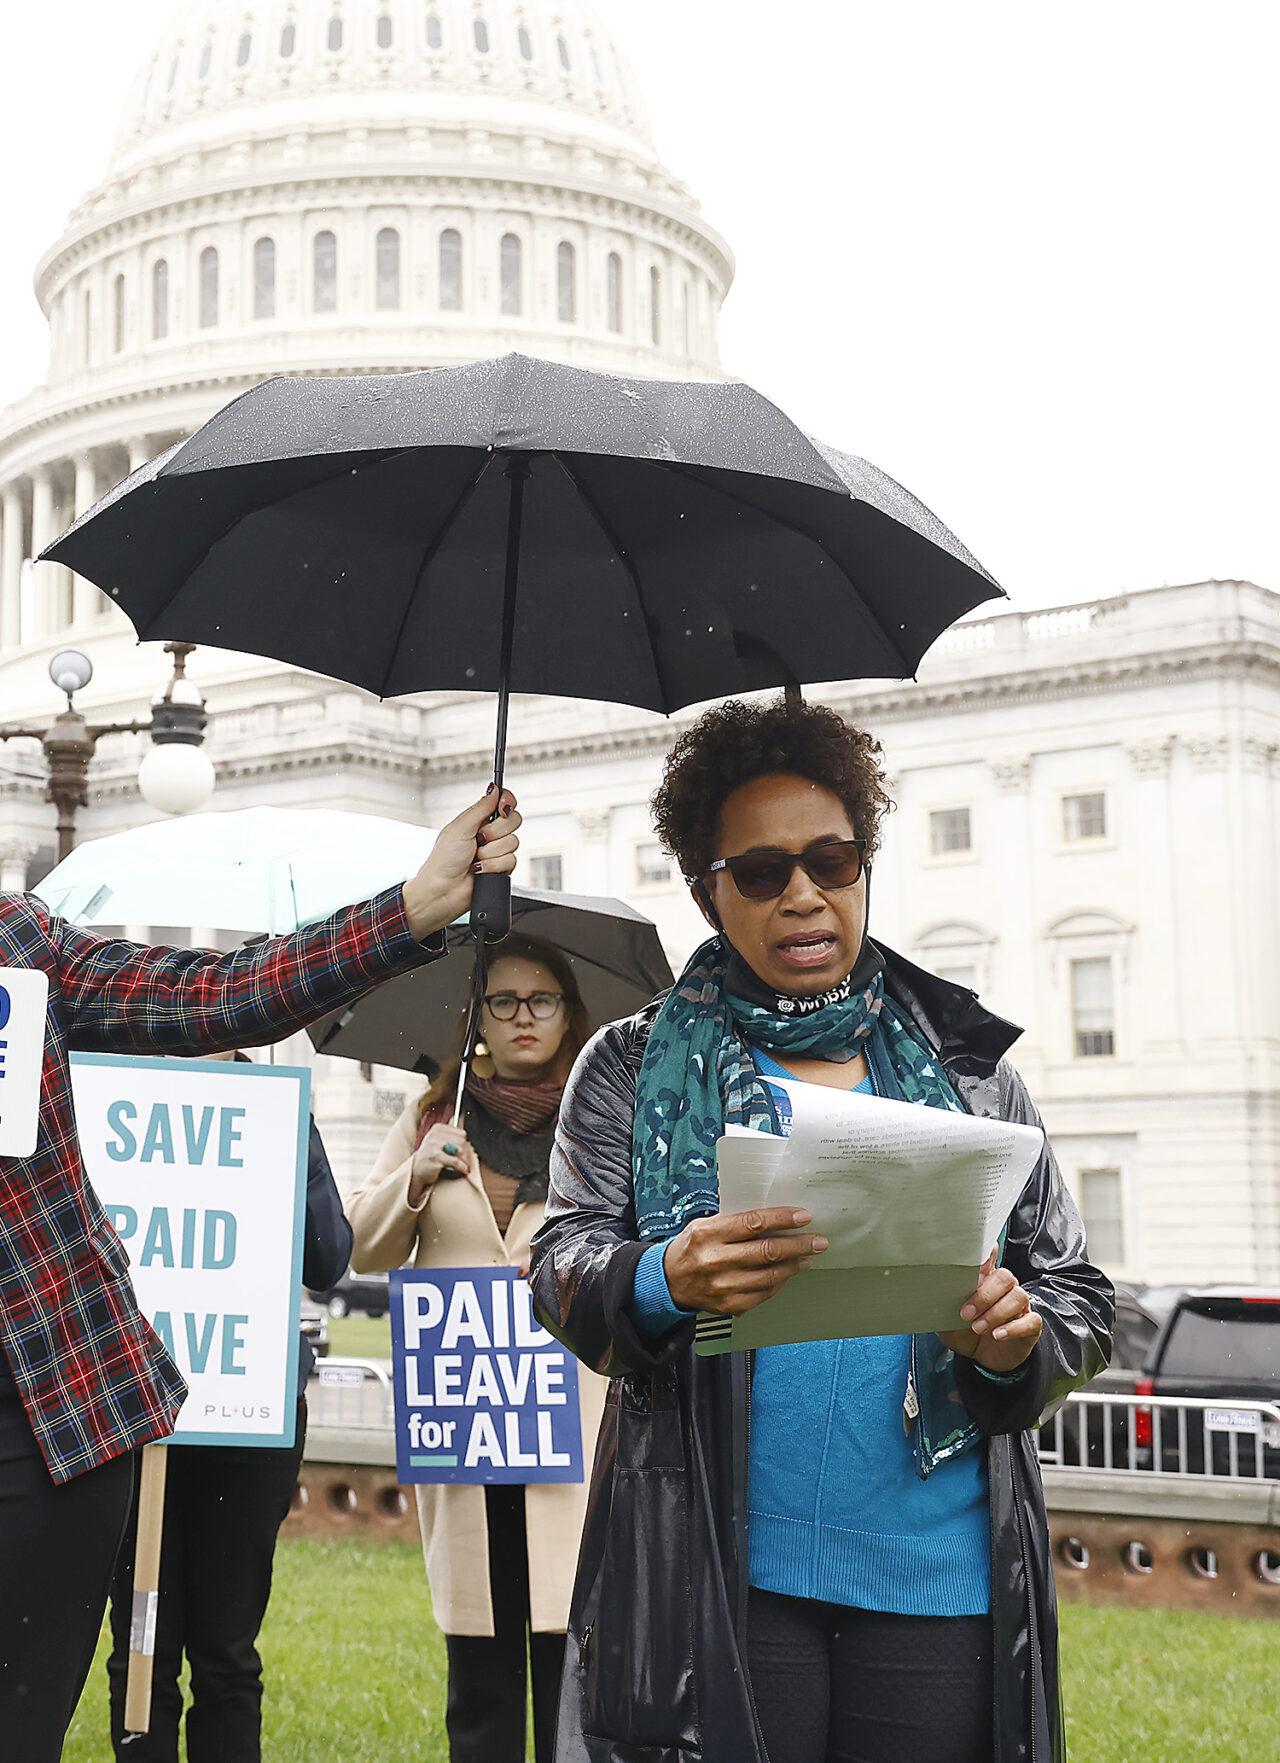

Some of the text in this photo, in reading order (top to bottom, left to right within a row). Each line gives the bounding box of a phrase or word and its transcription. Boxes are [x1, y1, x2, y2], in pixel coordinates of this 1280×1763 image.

[105, 1100, 247, 1168] SAVE
[105, 1204, 237, 1270] PAID
[402, 1279, 556, 1350] PAID
[405, 1352, 567, 1407] LEAVE
[408, 1411, 571, 1467] for ALL
